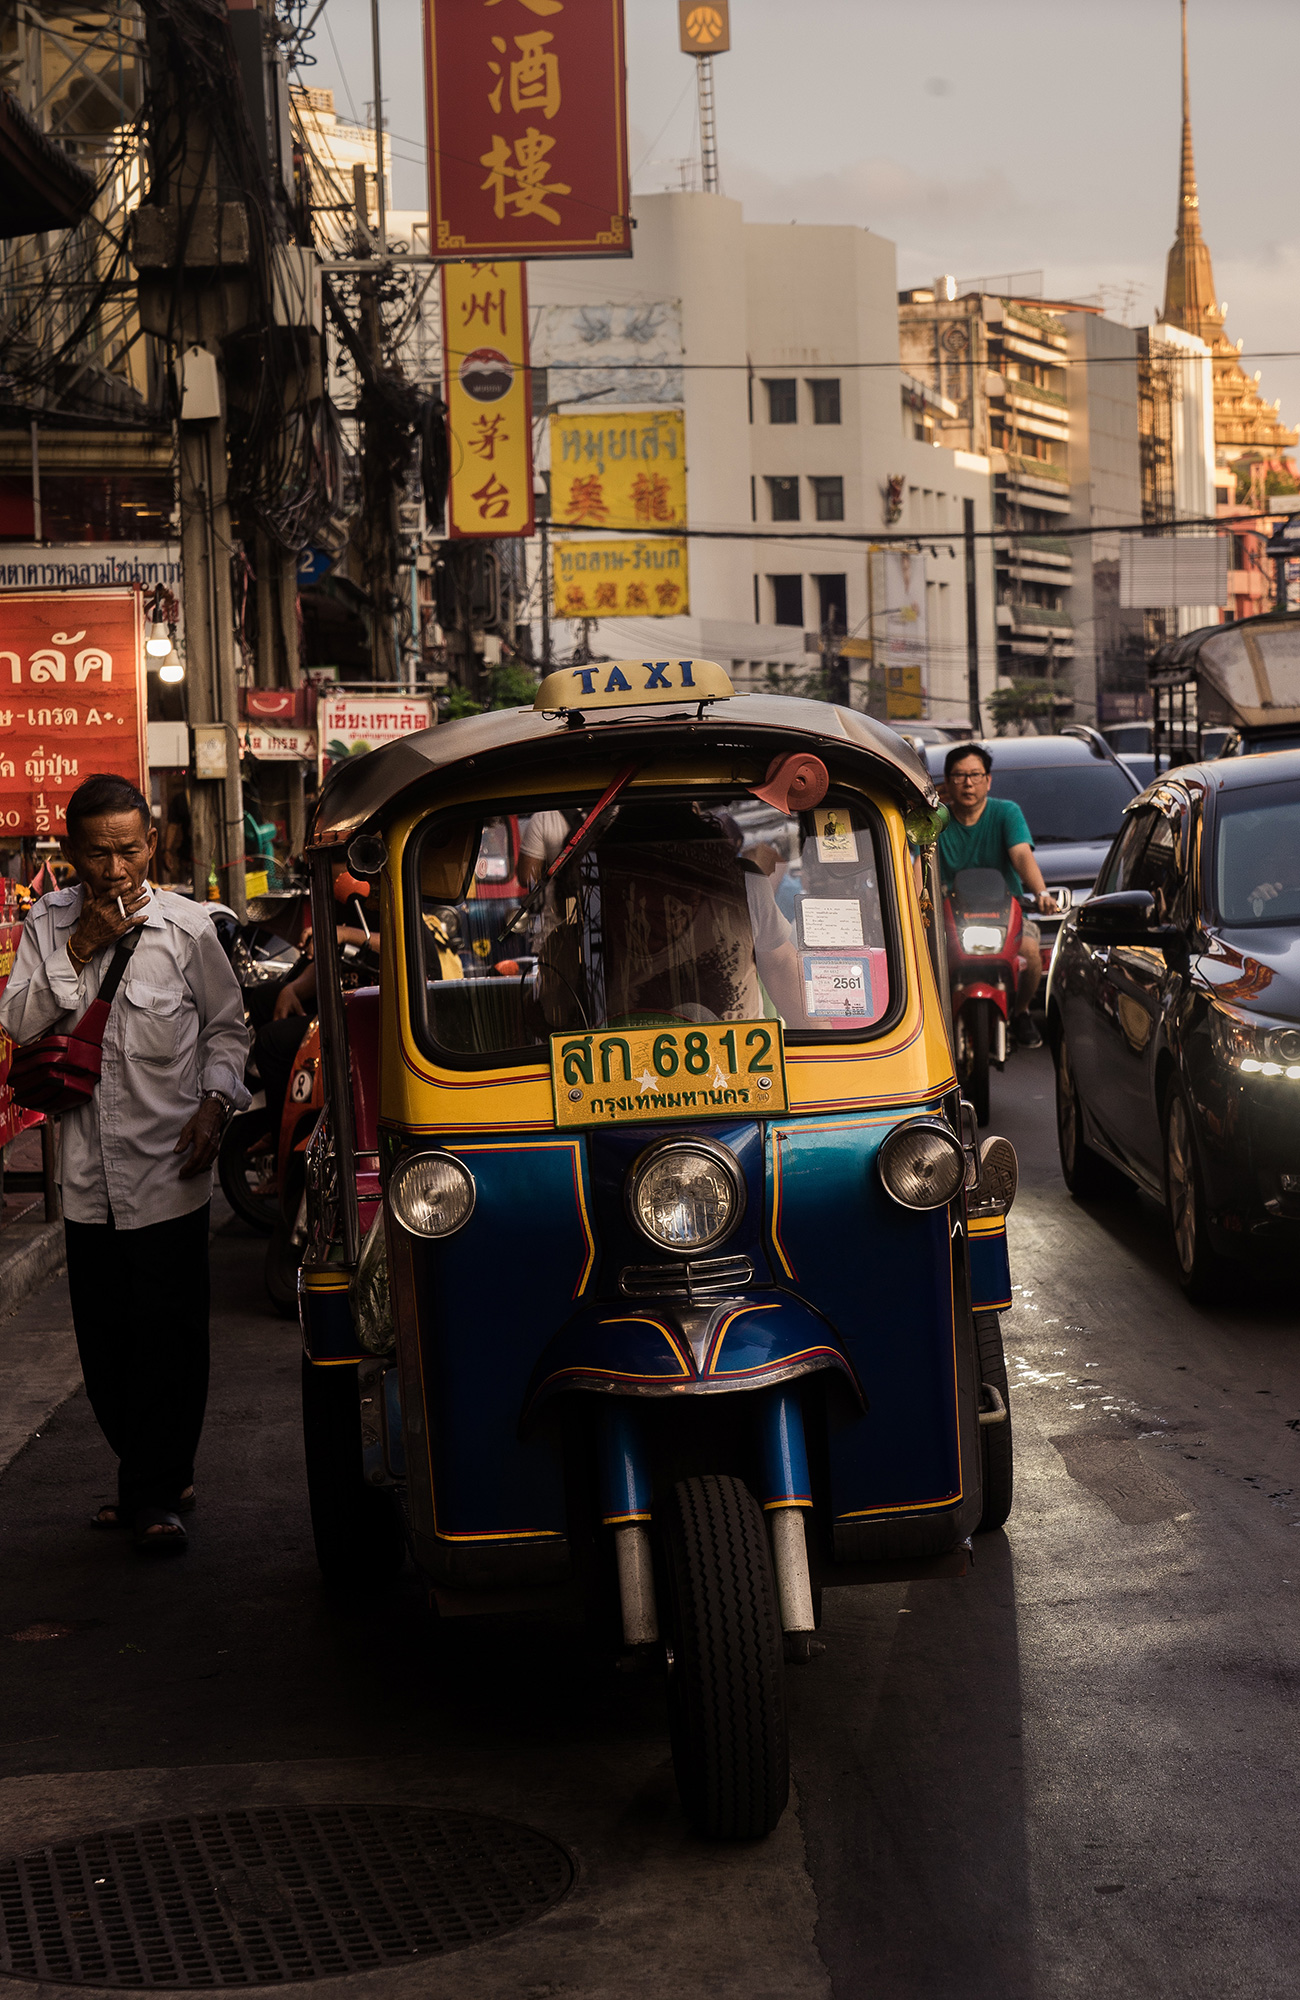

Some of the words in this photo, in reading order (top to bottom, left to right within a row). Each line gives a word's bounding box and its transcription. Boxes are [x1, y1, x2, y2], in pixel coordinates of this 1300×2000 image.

[573, 660, 696, 695] TAXI
[833, 977, 861, 989] 2561
[562, 1036, 632, 1085] สก
[653, 1028, 774, 1077] 6812
[591, 1088, 750, 1118] กรุงเทพมหานคร
